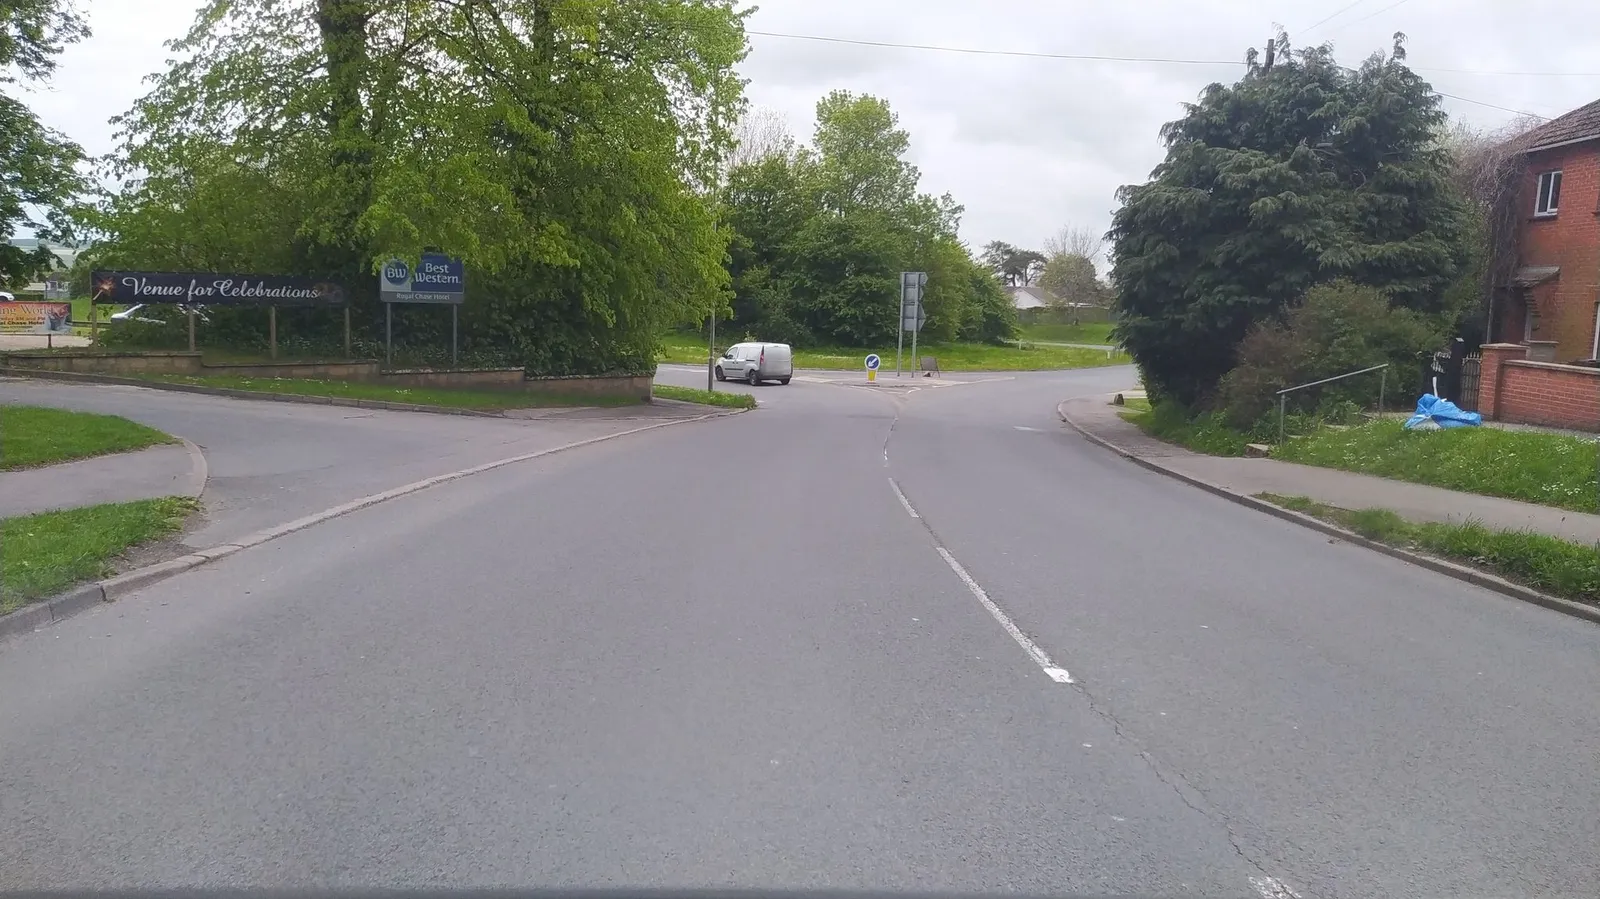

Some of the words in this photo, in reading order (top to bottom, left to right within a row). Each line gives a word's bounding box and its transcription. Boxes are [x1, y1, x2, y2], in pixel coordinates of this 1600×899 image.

[387, 267, 406, 279] BW
[425, 262, 450, 273] Best
[415, 272, 460, 284] Western
[122, 277, 185, 296] Venue
[187, 279, 215, 301] for
[212, 279, 321, 299] Celebrations
[20, 303, 53, 315] World
